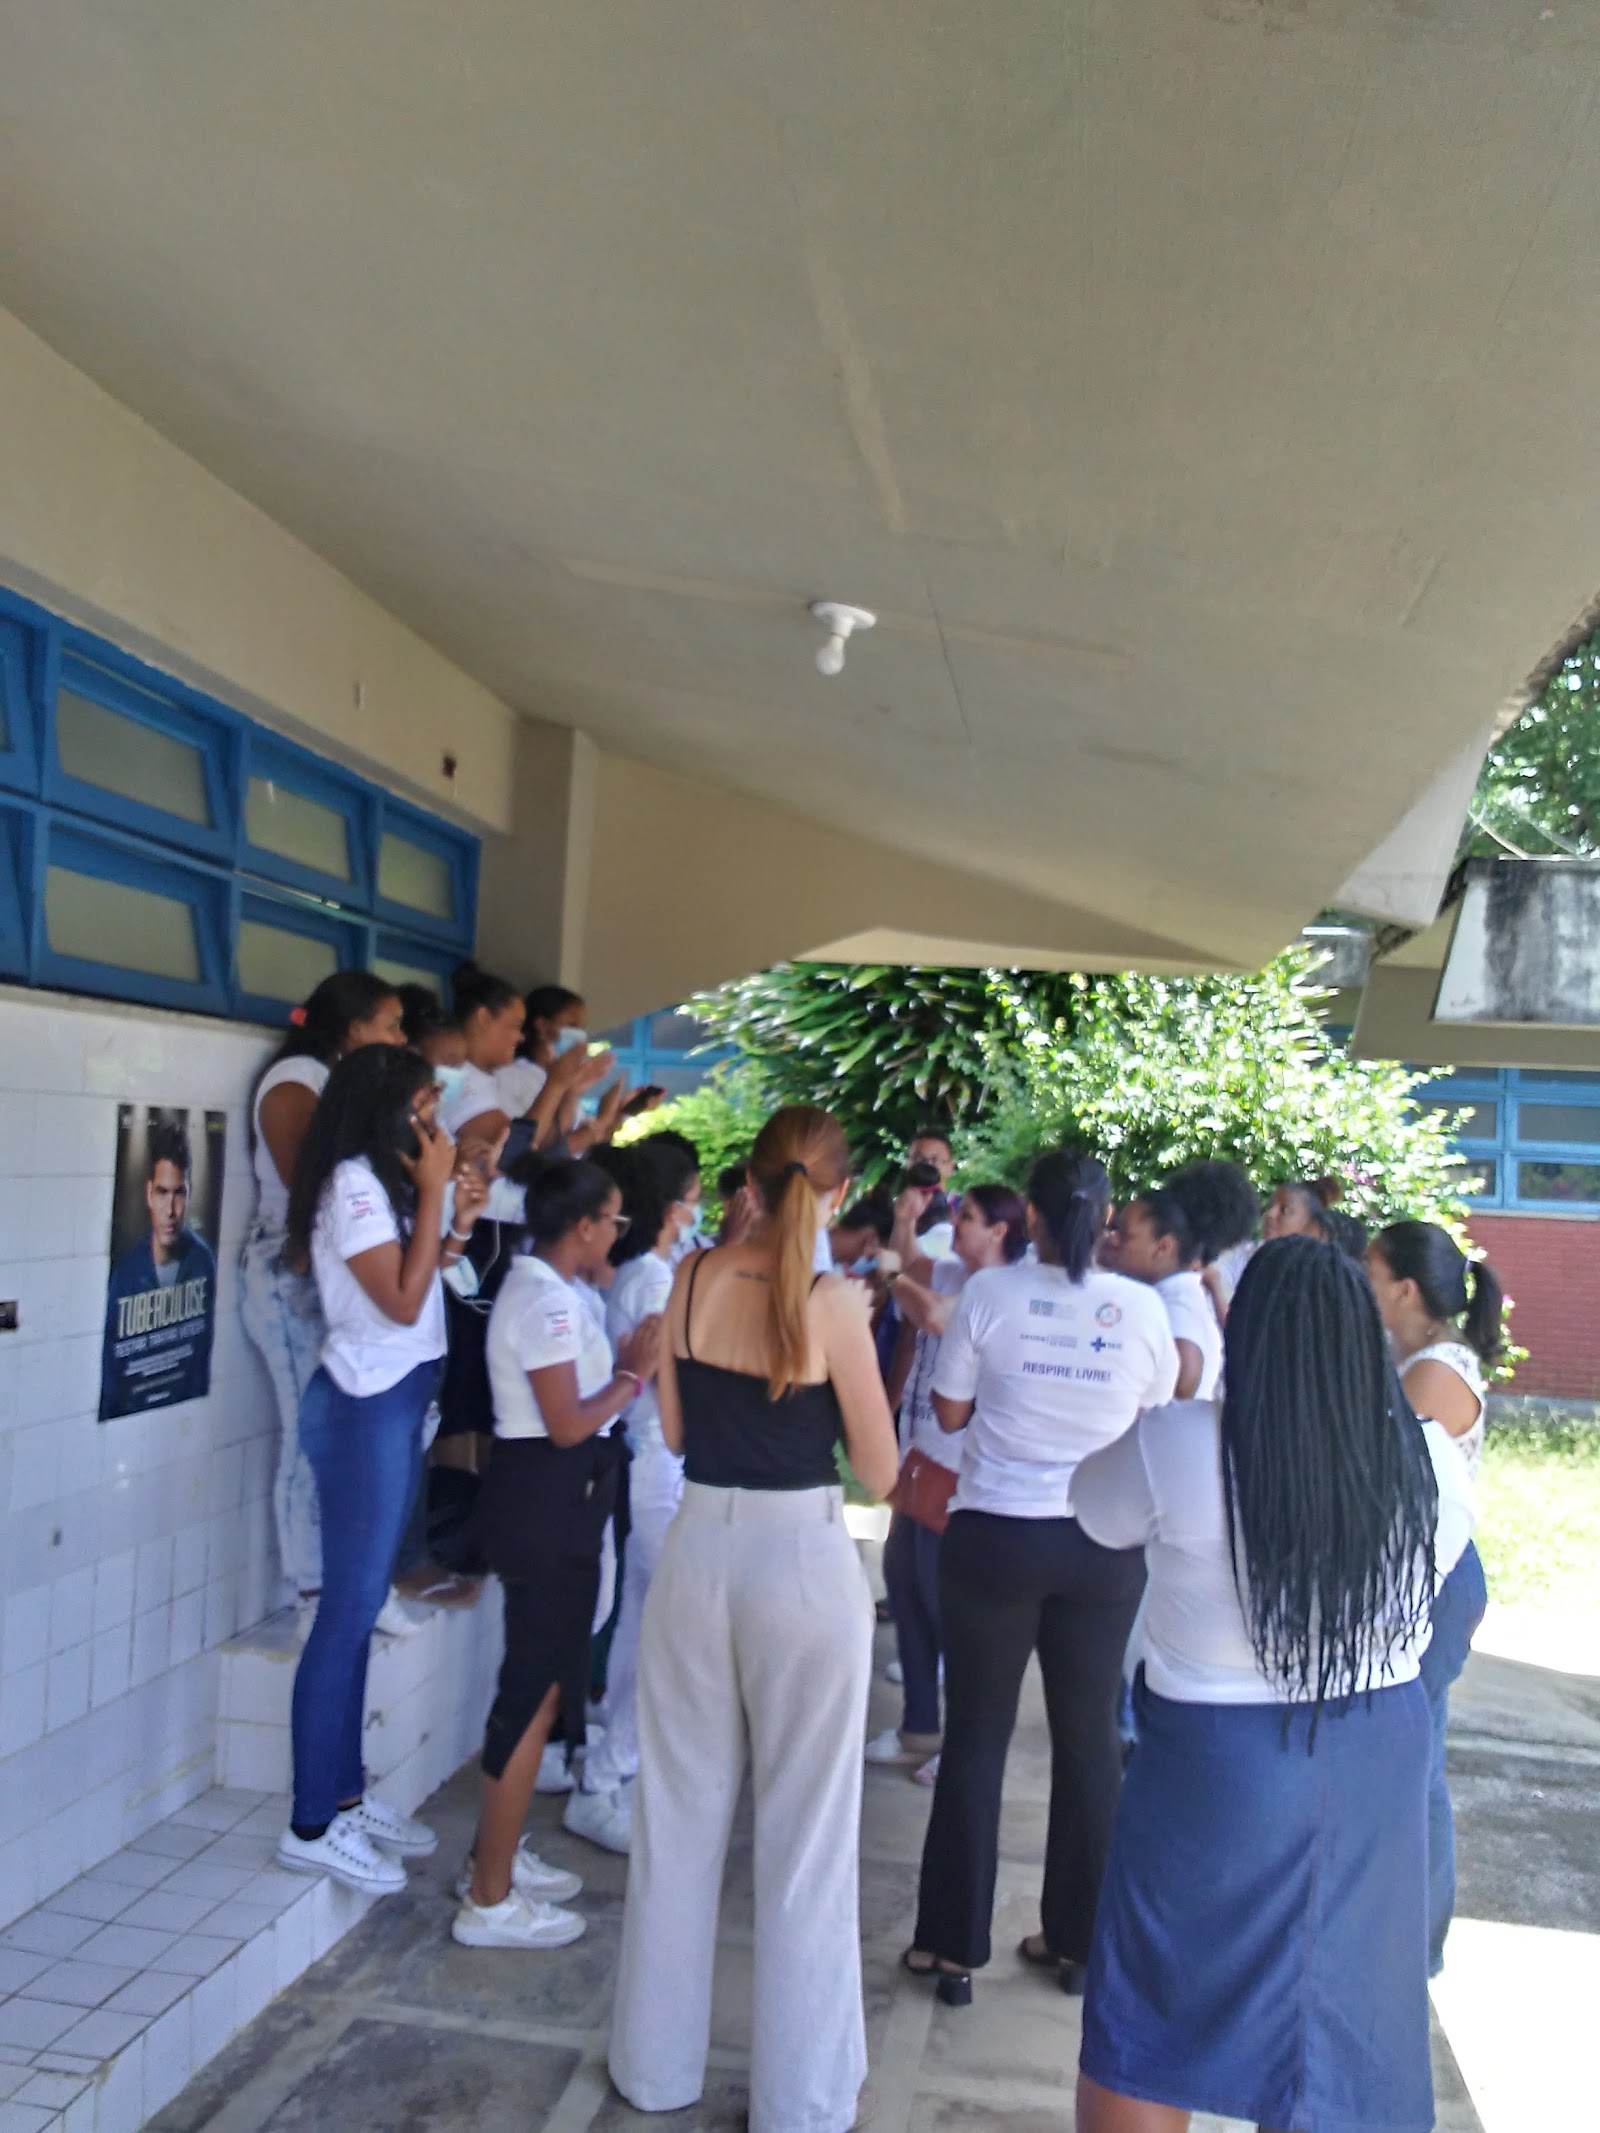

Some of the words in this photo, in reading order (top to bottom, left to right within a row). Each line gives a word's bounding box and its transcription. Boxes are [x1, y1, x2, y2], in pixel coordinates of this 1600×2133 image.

[118, 1277, 207, 1339] TUBERCULOSE
[1022, 1361, 1072, 1378] RESPIRE
[1075, 1369, 1111, 1382] LIVRE!
